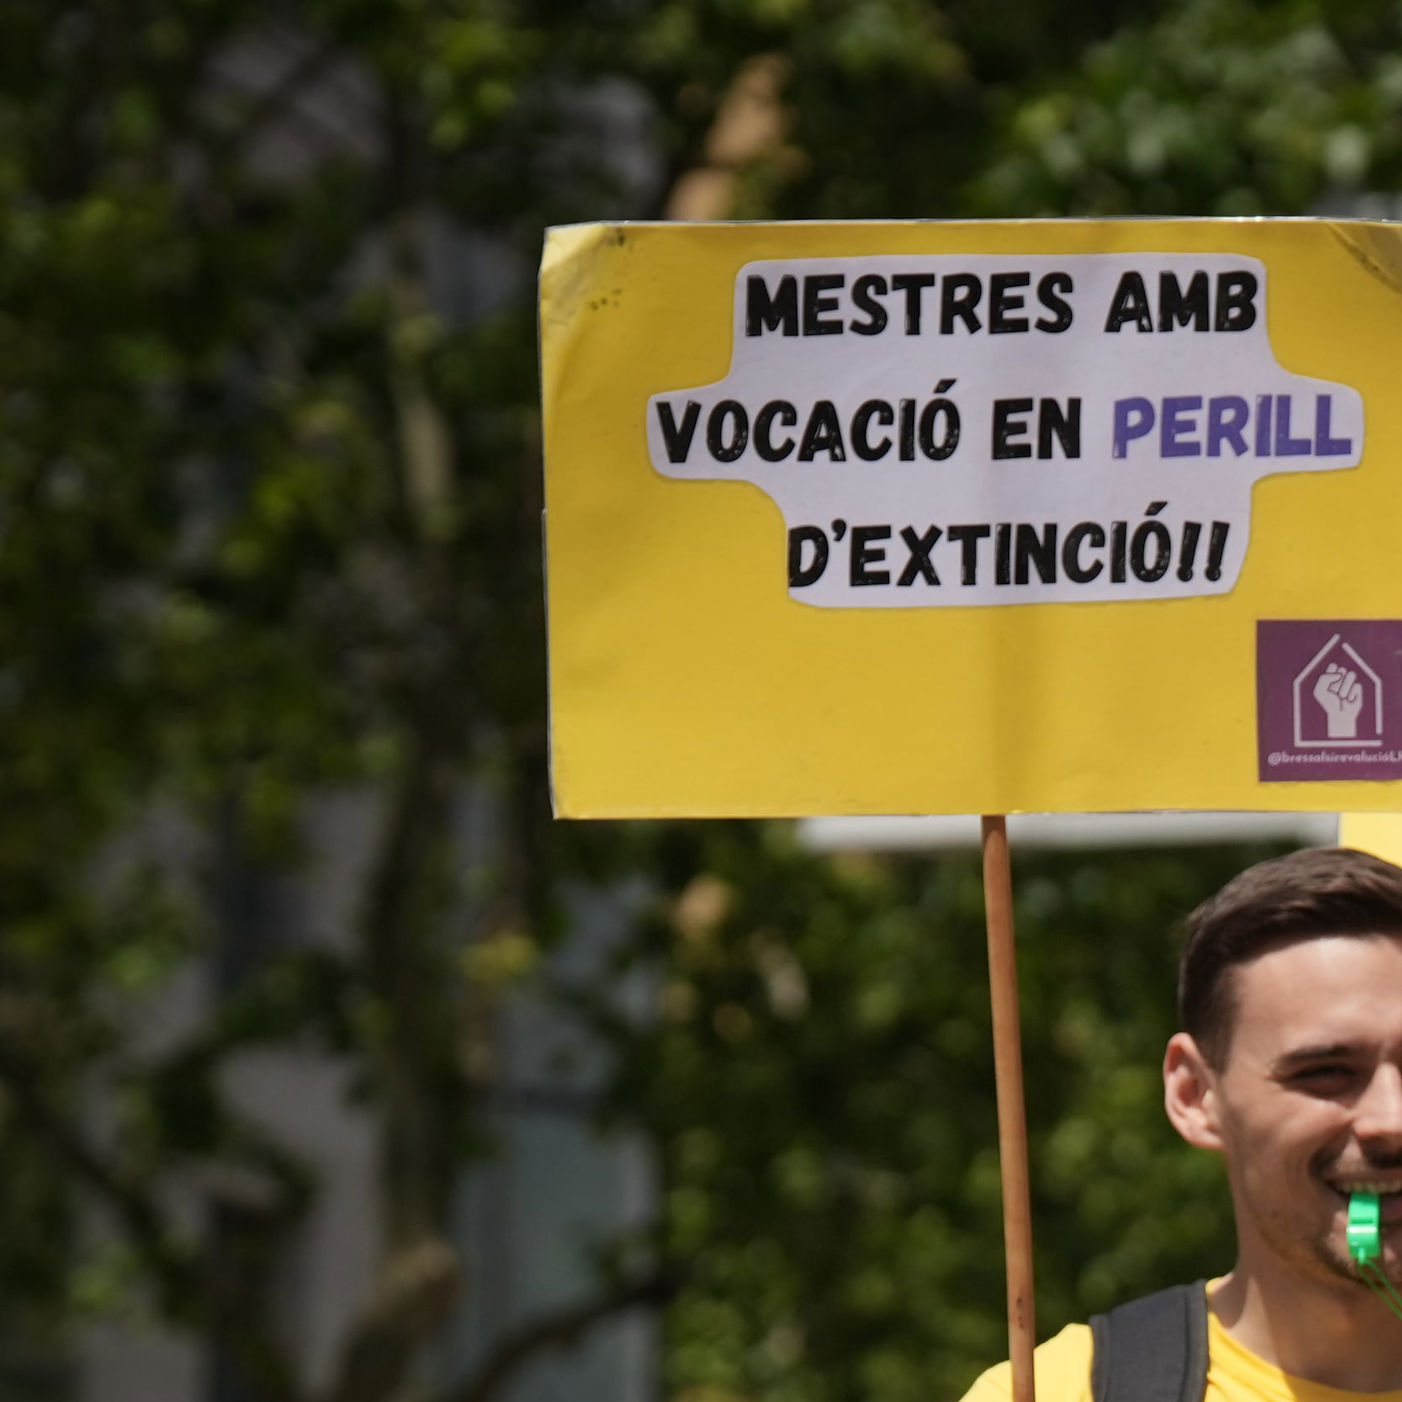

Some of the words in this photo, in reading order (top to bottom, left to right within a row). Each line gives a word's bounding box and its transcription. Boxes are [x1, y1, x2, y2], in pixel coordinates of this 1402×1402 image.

[745, 270, 1075, 338] MESTRES
[1104, 269, 1259, 334] AMB
[656, 378, 963, 465] VOCACIÓ
[991, 396, 1082, 462] EN
[1111, 394, 1353, 460] PERILL
[786, 500, 1231, 588] D'EXTINCIÓ!!
